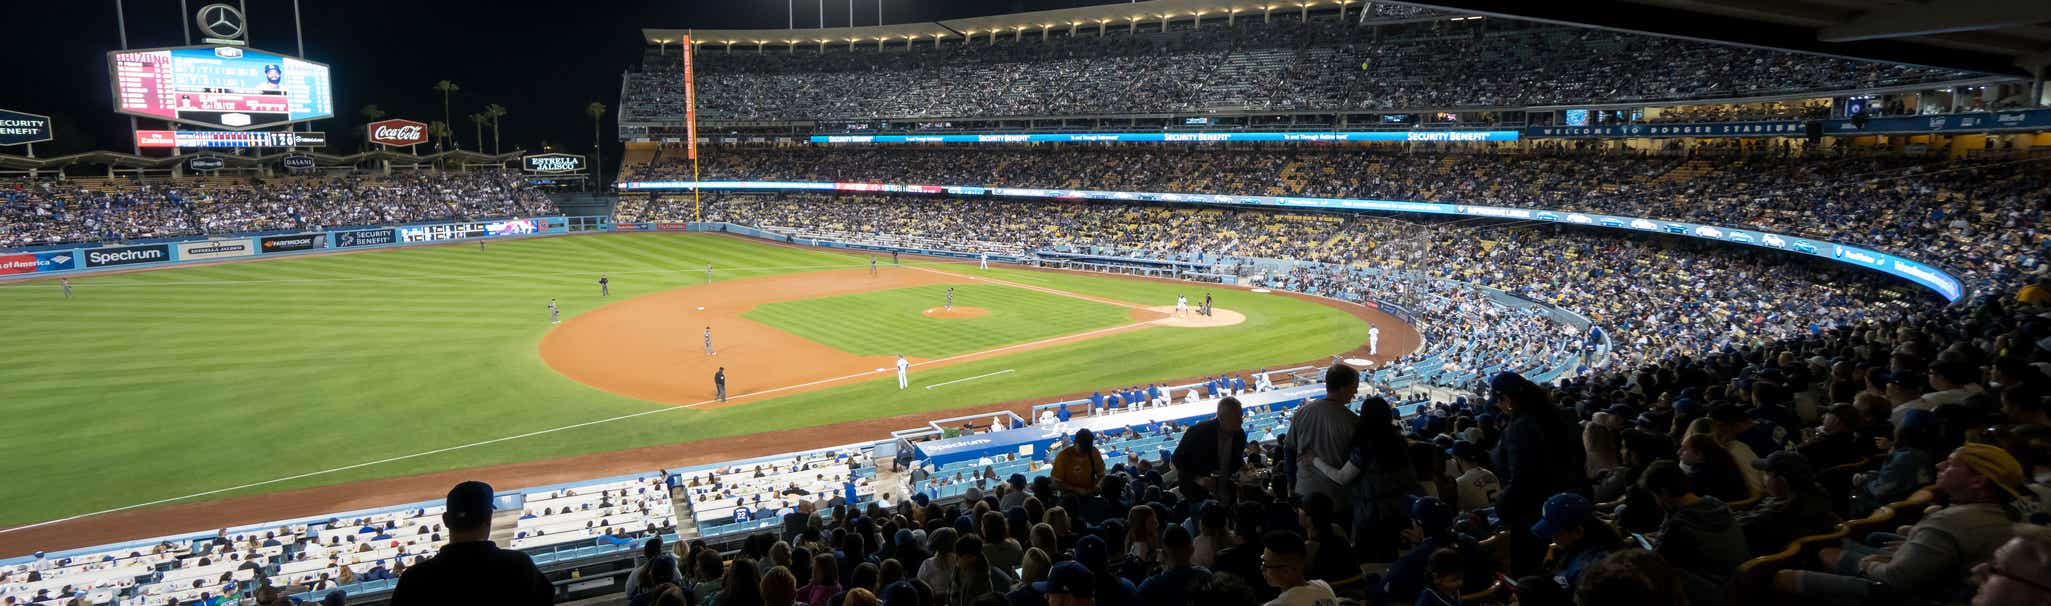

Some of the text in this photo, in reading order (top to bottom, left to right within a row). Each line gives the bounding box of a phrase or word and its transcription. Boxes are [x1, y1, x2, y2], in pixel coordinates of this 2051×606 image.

[1723, 124, 1796, 132] STADIUM
[375, 125, 421, 141] Coca-Cola
[1164, 133, 1198, 141] SECURITY
[1407, 132, 1449, 141] SECURITY
[532, 157, 579, 165] ESTRELLA
[537, 163, 574, 171] JALISCO
[356, 230, 392, 239] SECURITY
[90, 249, 161, 265] Spectrum
[3, 260, 50, 270] of America
[737, 511, 746, 520] 22
